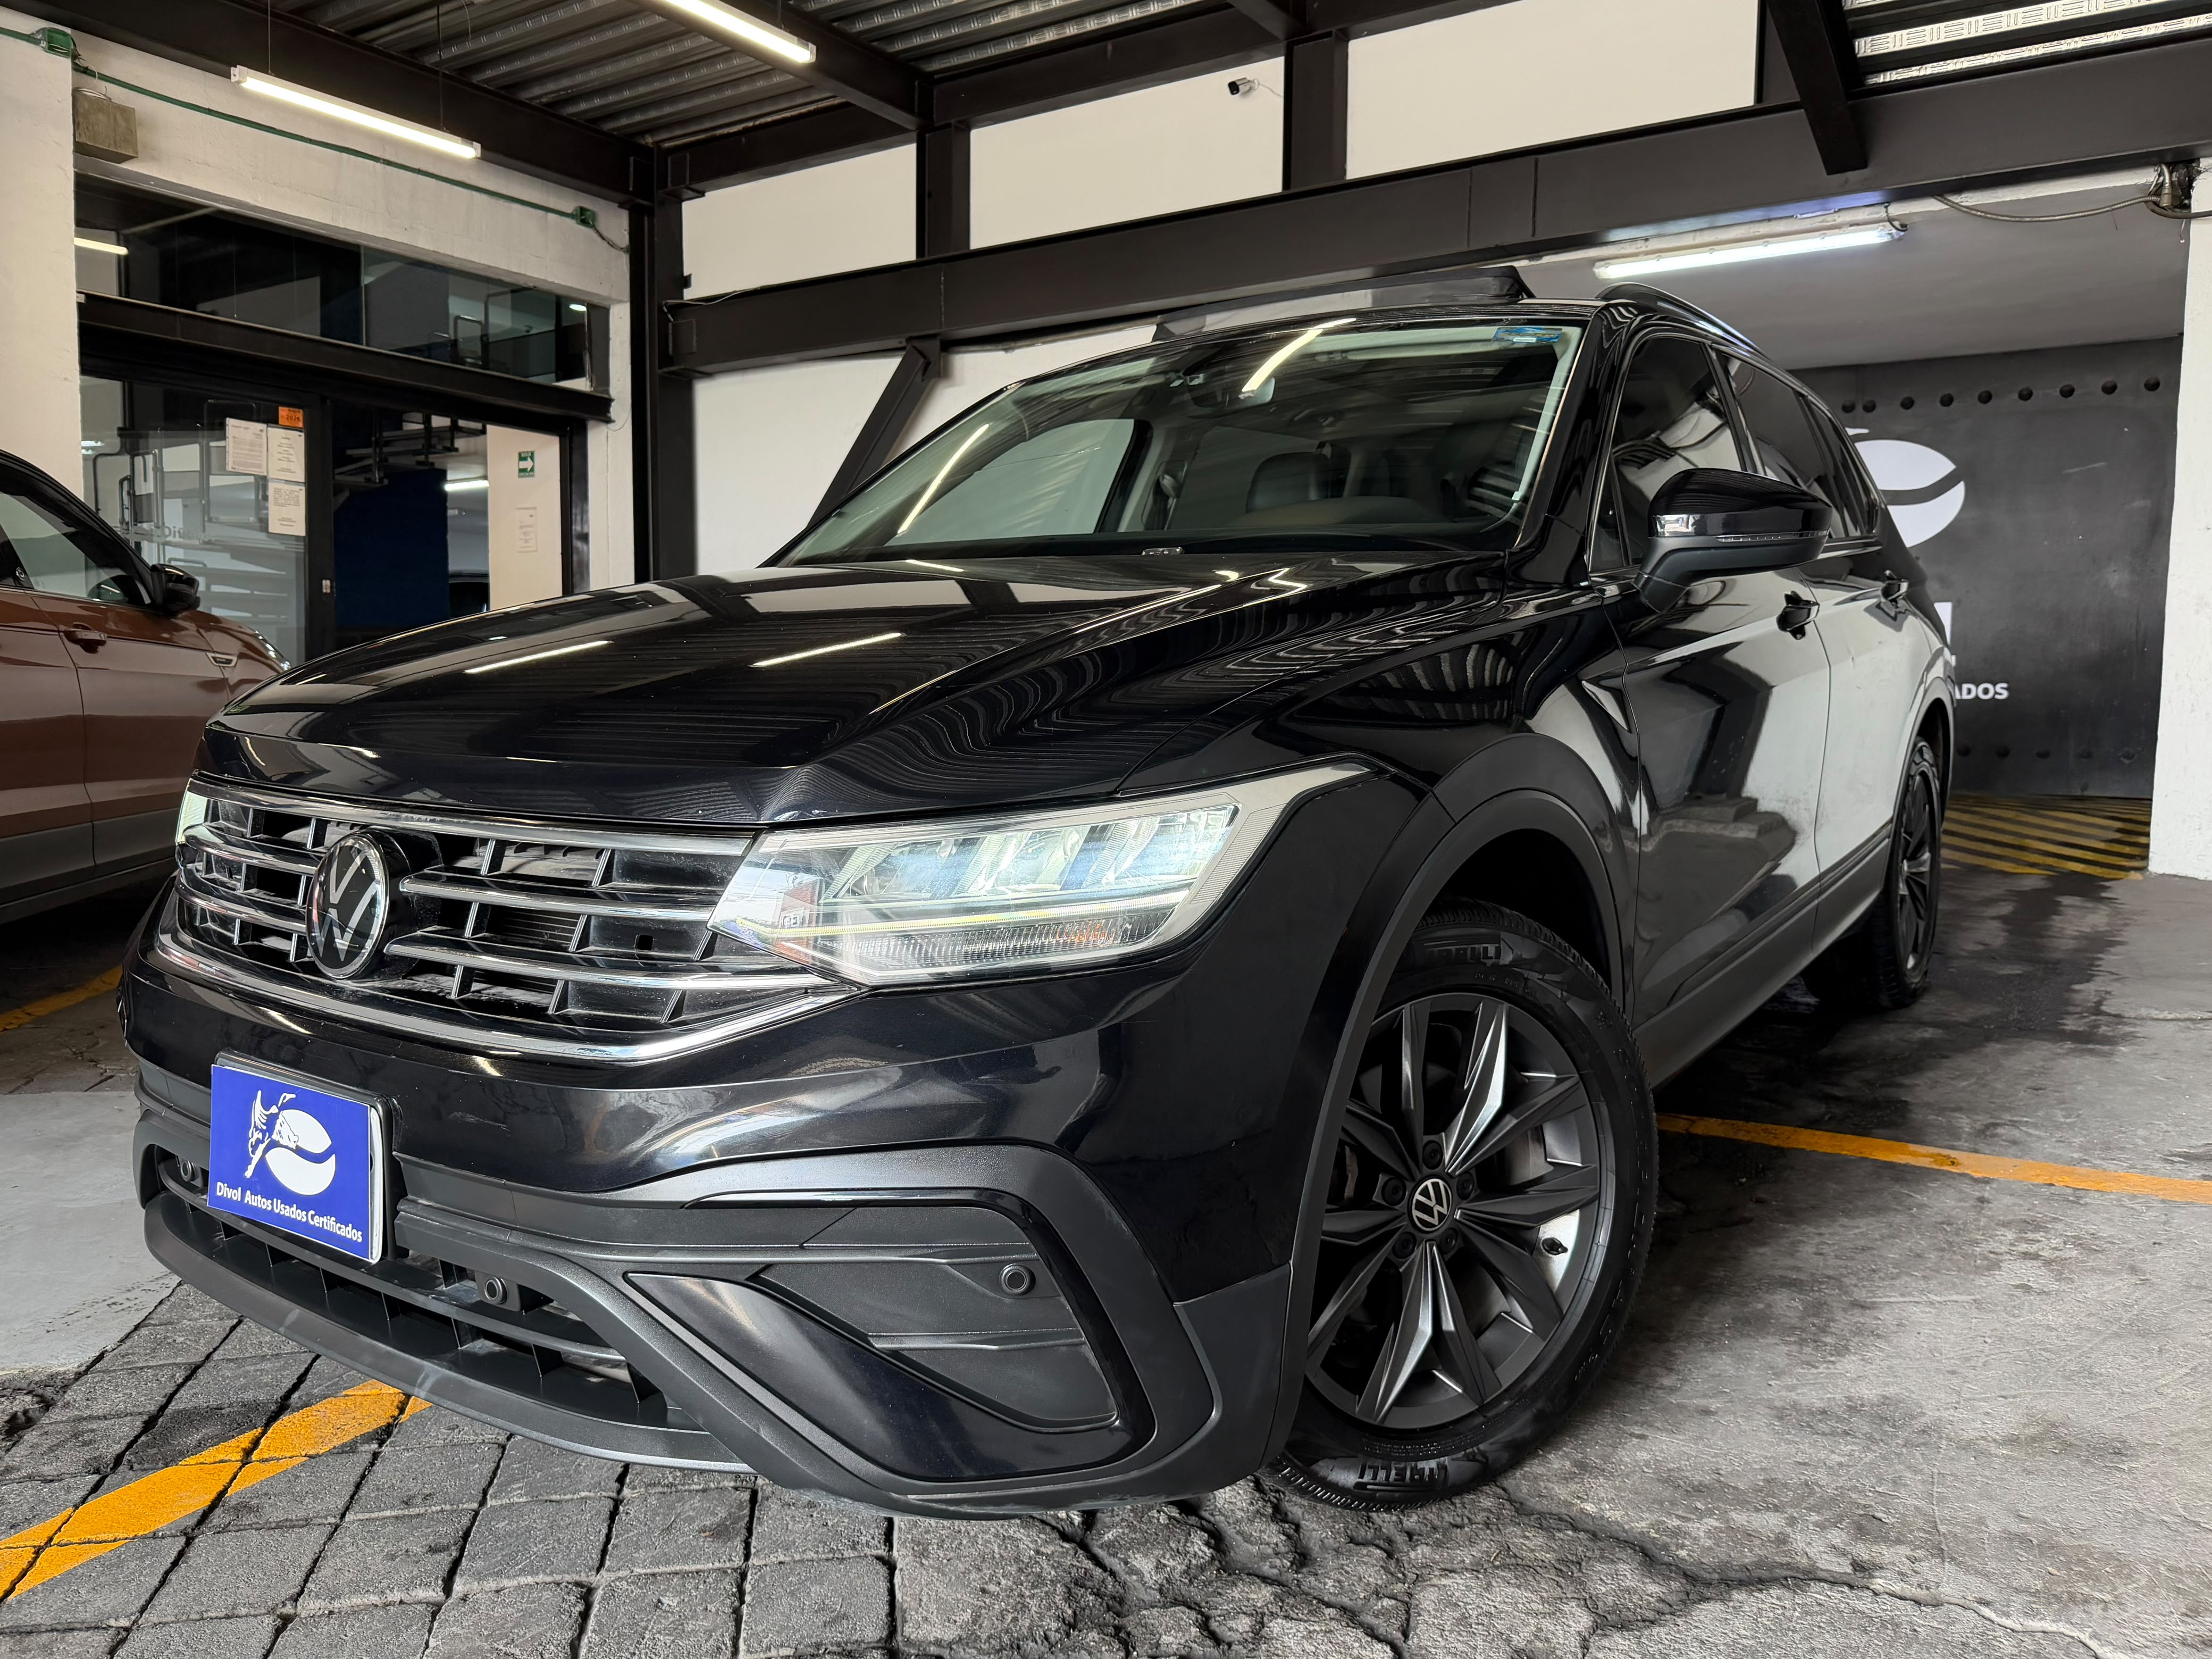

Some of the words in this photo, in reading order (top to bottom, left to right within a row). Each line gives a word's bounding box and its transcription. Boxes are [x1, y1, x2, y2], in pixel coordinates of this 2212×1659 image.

[216, 1182, 241, 1202] Divol
[244, 1189, 272, 1211] Autos
[273, 1198, 307, 1222] Usados
[307, 1210, 363, 1243] Certificados
[1412, 1178, 1452, 1231] VW
